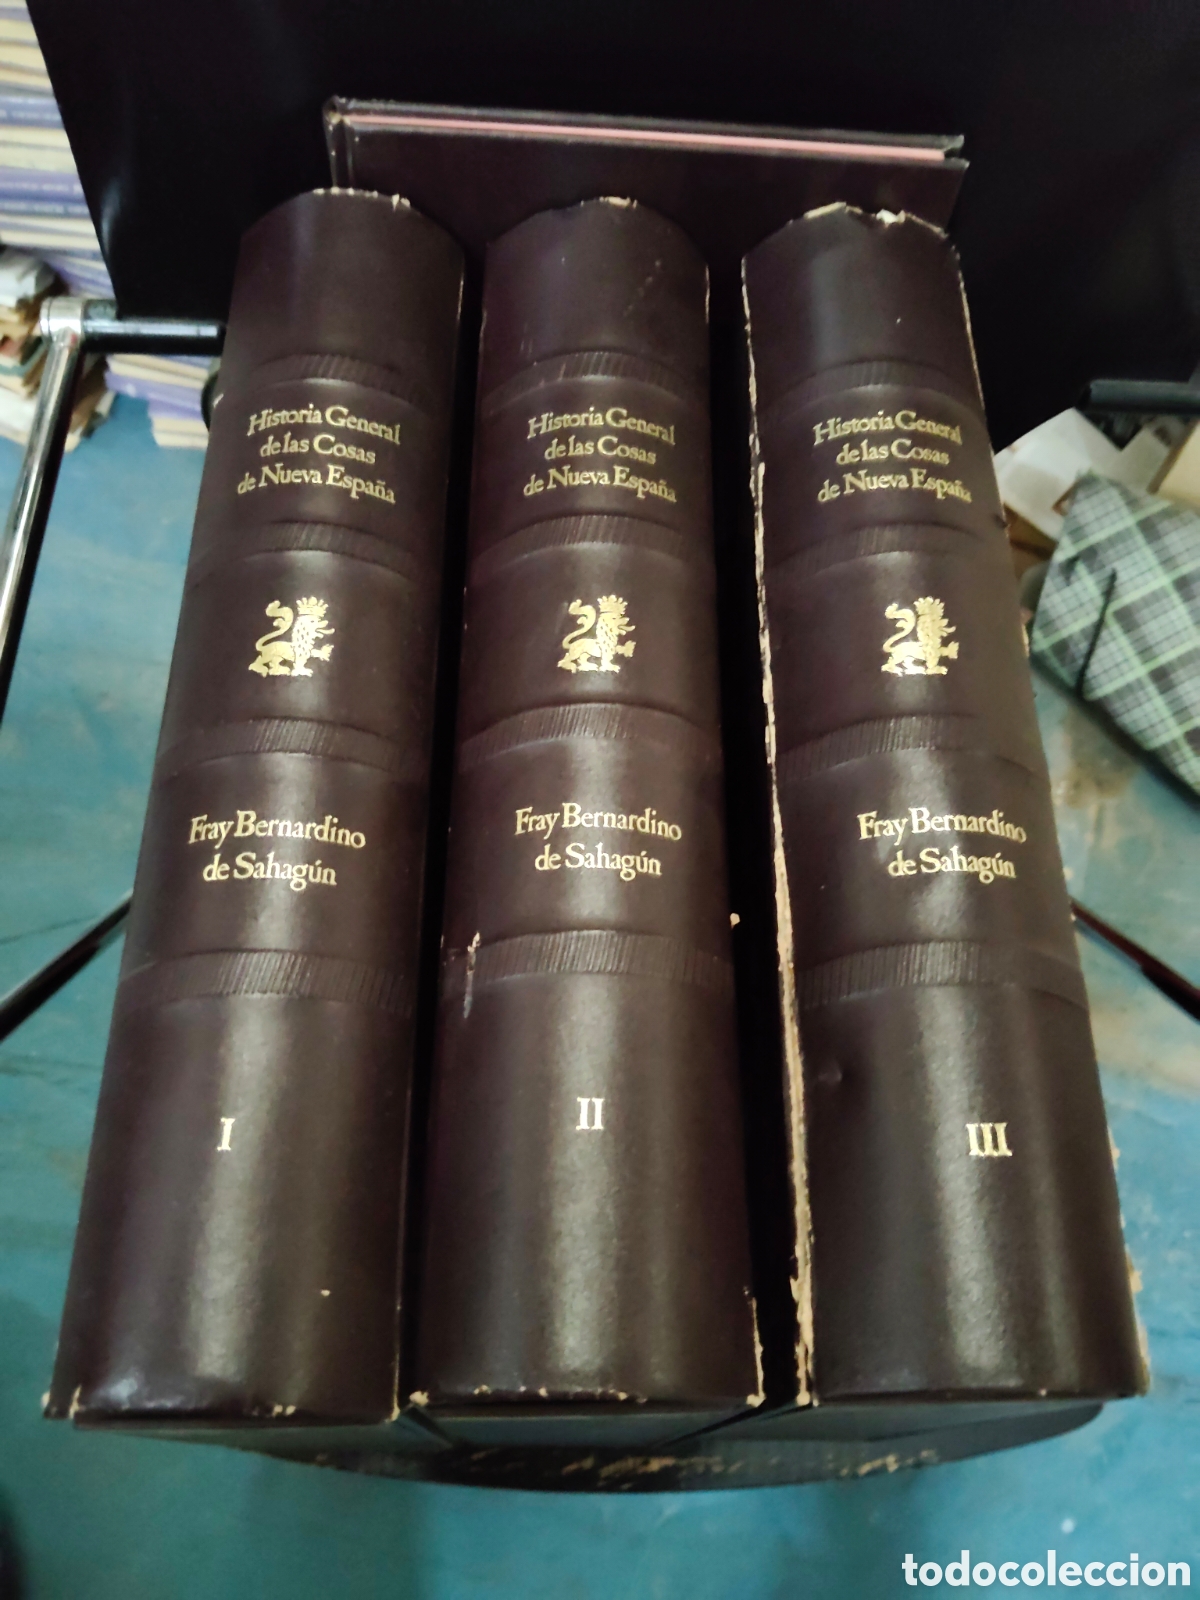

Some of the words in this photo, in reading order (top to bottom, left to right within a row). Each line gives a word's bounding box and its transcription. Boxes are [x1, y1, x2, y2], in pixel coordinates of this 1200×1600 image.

[247, 402, 324, 437] Historia
[325, 405, 401, 446] General
[526, 406, 604, 440] Historia
[605, 407, 676, 446] General
[812, 409, 896, 446] Historia
[895, 409, 963, 446] General
[260, 435, 281, 458] de
[282, 431, 310, 454] las
[313, 433, 376, 465] Cosas
[544, 437, 567, 461] de
[567, 434, 595, 457] las
[597, 435, 657, 465] Cosas
[836, 442, 860, 466] de
[860, 439, 889, 461] las
[890, 438, 950, 466] Cosas
[237, 472, 257, 495] de
[258, 462, 323, 488] Nueva
[325, 463, 396, 505] España
[523, 473, 545, 497] de
[546, 464, 611, 490] Nueva
[612, 464, 678, 503] España
[817, 479, 841, 503] de
[843, 469, 910, 495] Nueva
[909, 467, 973, 504] España
[188, 814, 235, 850] Fray
[233, 809, 367, 849] Bernardino
[514, 806, 561, 840] Fray
[561, 802, 683, 842] Bernardino
[857, 810, 909, 846] Fray
[908, 806, 1028, 844] Bernardino
[202, 853, 231, 882] de
[233, 851, 338, 892] Sahagún
[534, 843, 562, 872] de
[565, 841, 663, 882] Sahagún
[888, 850, 918, 877] de
[919, 845, 1017, 885] Sahagún
[575, 1097, 605, 1131] II
[217, 1117, 236, 1152] I
[965, 1122, 1013, 1157] III
